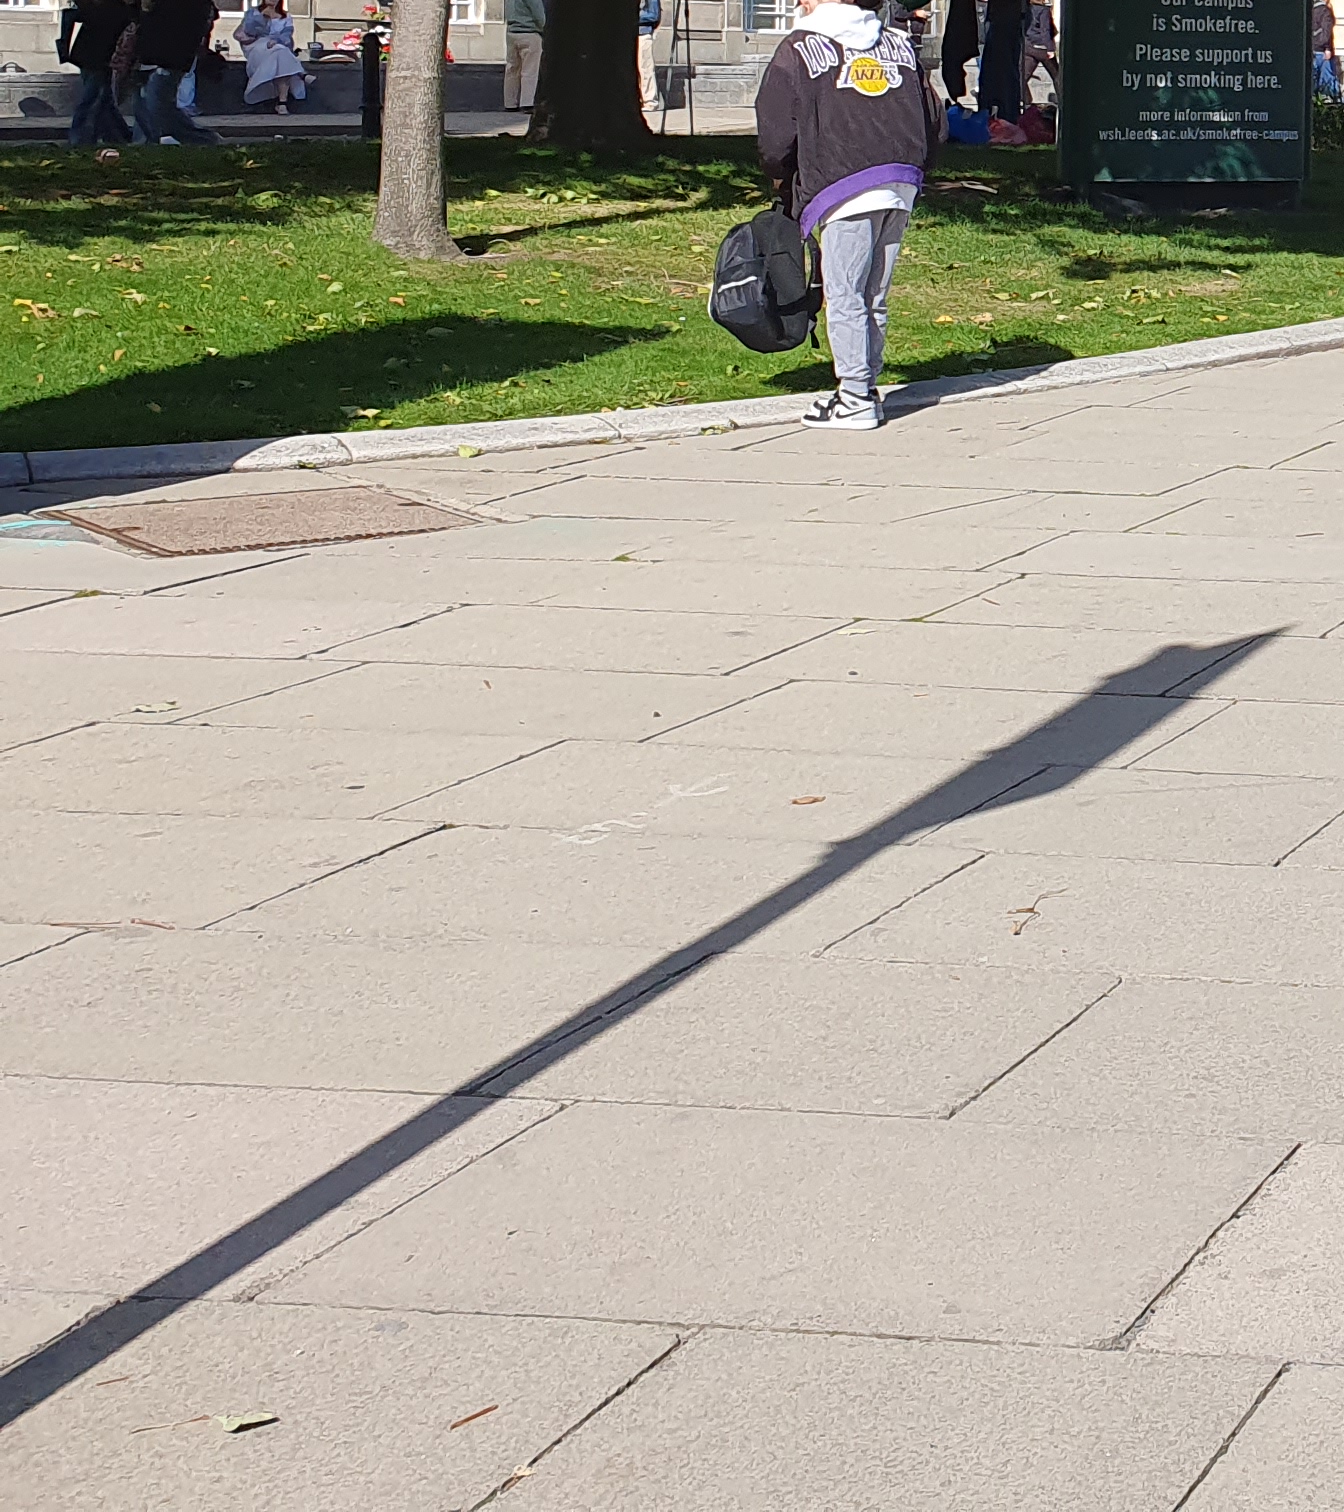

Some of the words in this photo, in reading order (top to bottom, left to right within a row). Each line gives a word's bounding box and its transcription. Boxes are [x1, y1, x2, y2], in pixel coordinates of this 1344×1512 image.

[1152, 13, 1166, 32] is
[1171, 14, 1260, 34] Smokefree.
[793, 34, 839, 79] LOS
[1135, 43, 1190, 62] Please
[1195, 47, 1253, 66] support
[1257, 50, 1273, 64] us
[837, 63, 903, 89] LAKERS
[1122, 69, 1142, 91] by
[1146, 71, 1172, 87] not
[1177, 70, 1244, 92] smoking
[1247, 71, 1282, 89] here.
[1139, 110, 1171, 122] more
[1174, 108, 1242, 122] information
[1244, 108, 1269, 122] from
